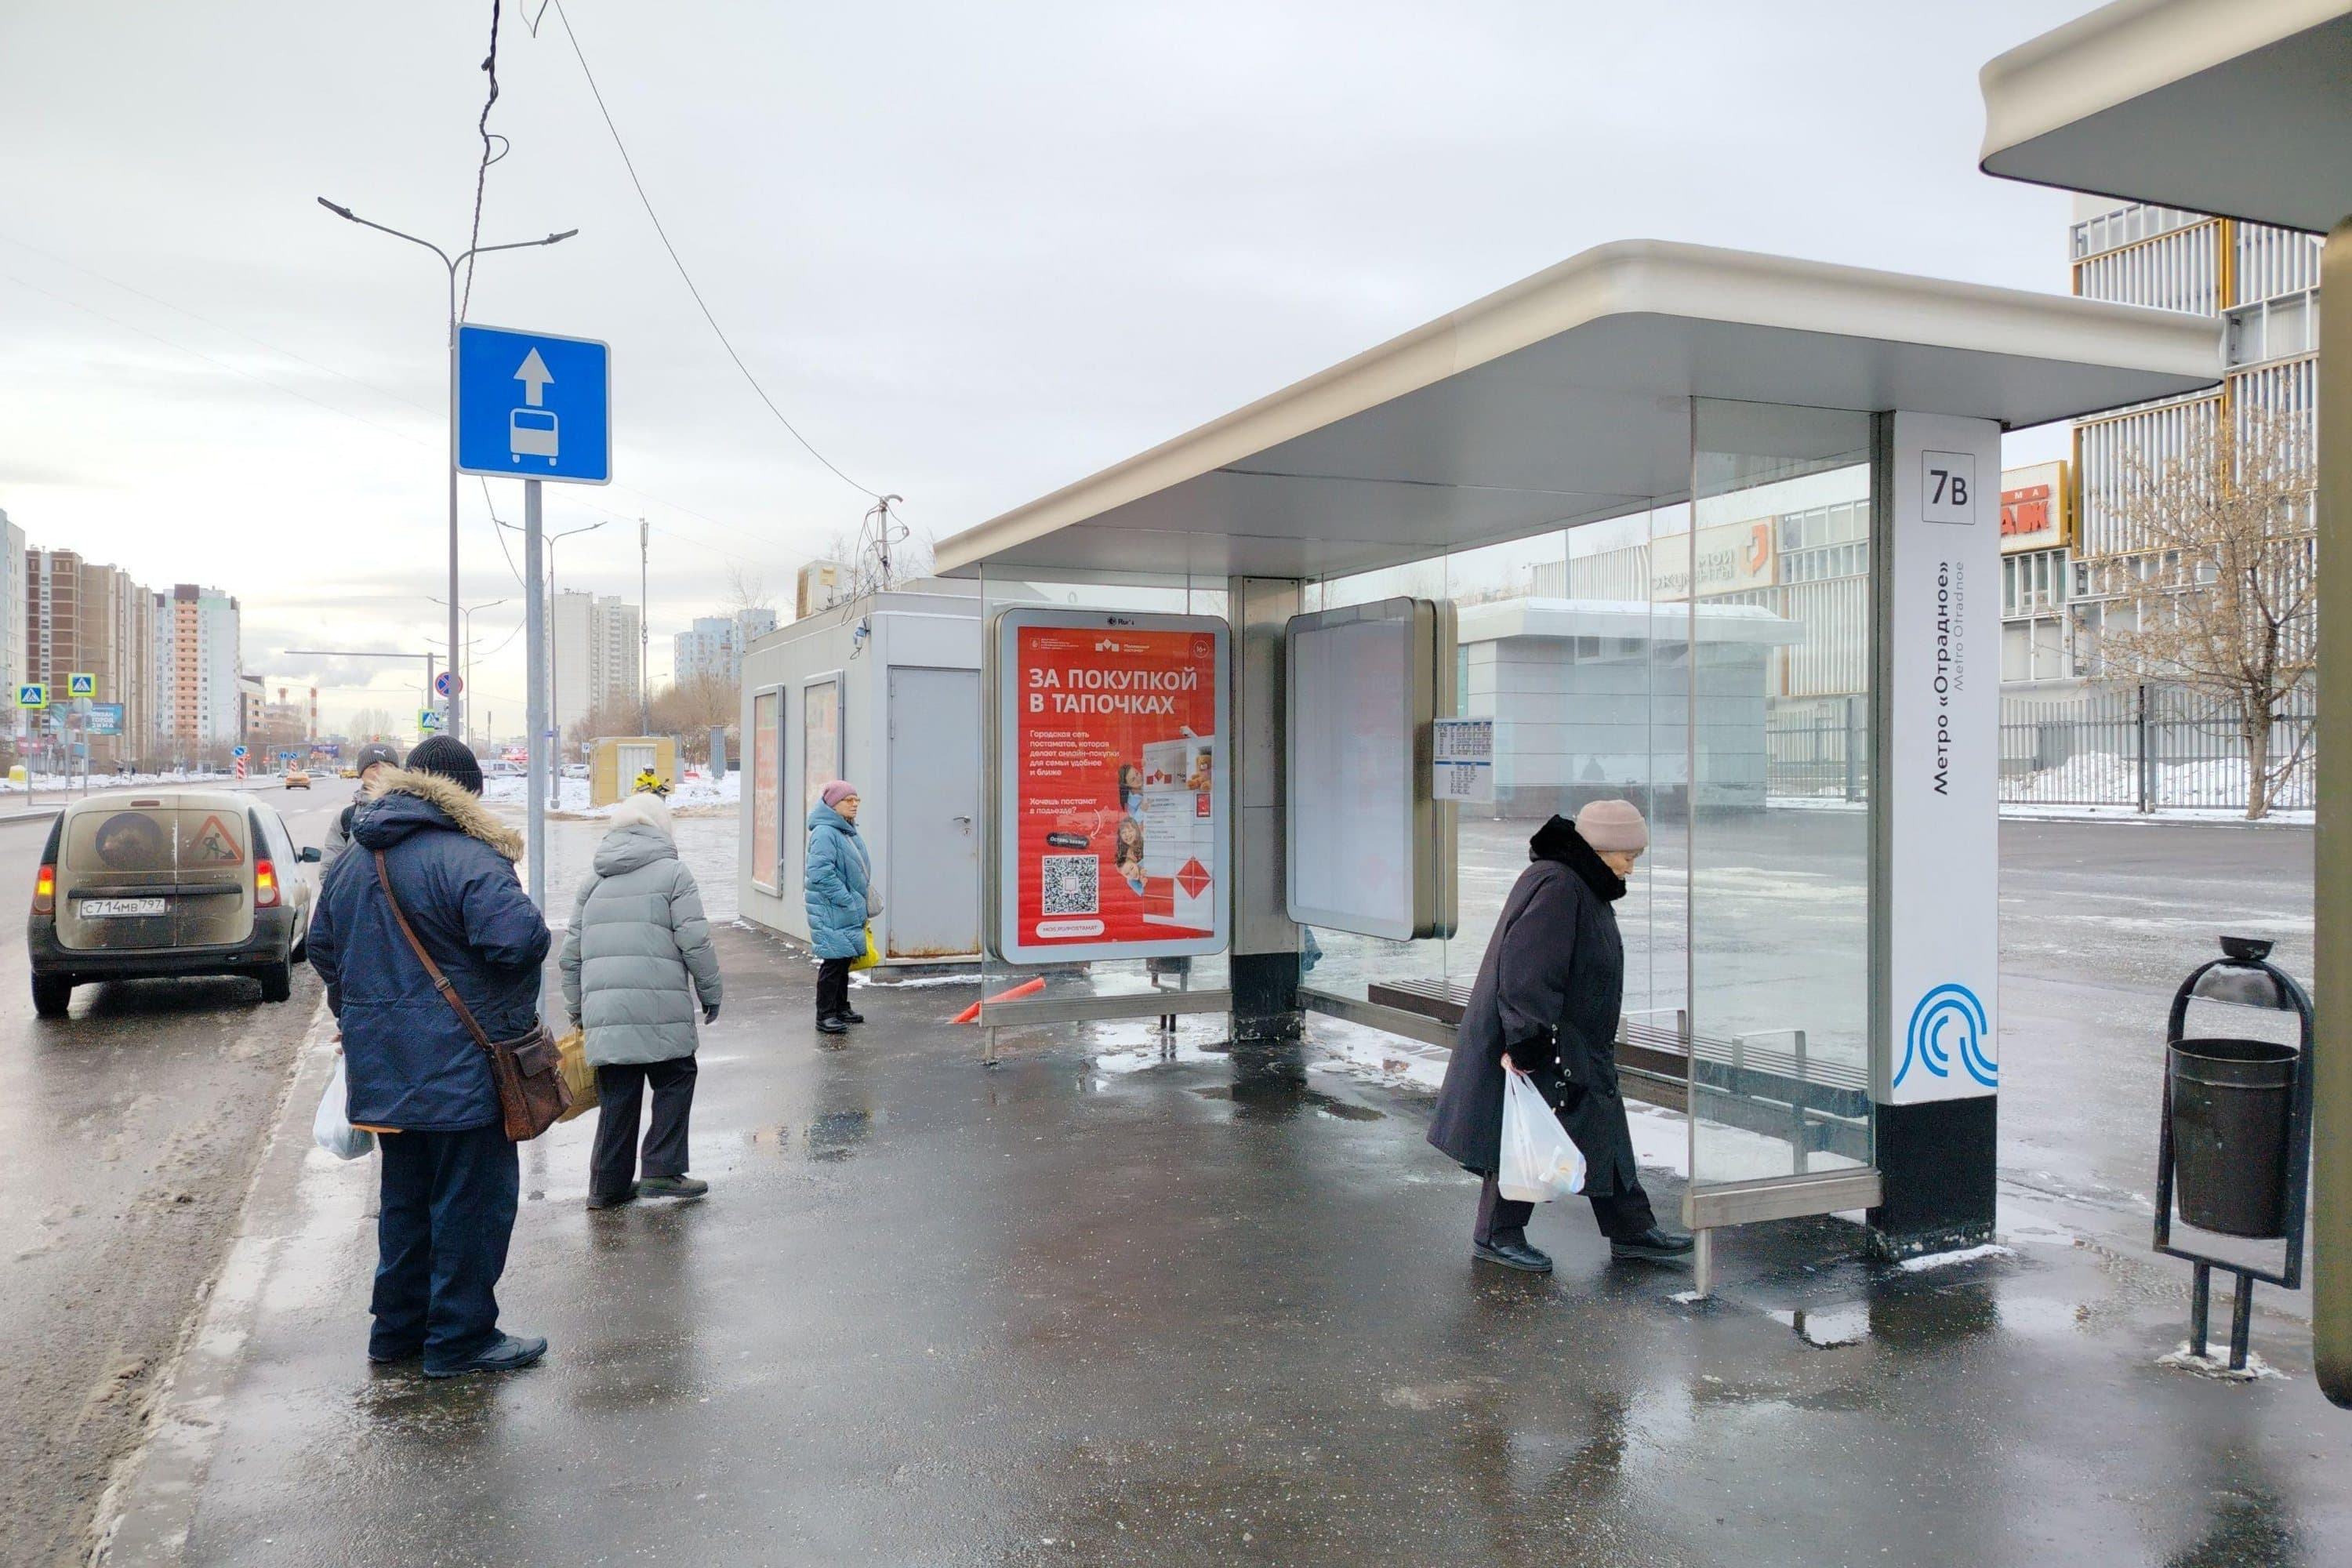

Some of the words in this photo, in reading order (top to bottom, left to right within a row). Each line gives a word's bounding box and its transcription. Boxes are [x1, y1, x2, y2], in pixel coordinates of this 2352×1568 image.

[1953, 561, 1964, 637] Otradnoe
[1933, 561, 1951, 706] «Отрадное»
[1029, 668, 1060, 688] ЗА
[1068, 666, 1198, 691] ПОКУПКОЙ
[1954, 643, 1964, 691] Metro
[1029, 693, 1044, 713] В
[1051, 693, 1174, 714] ТАПОЧКАХ
[1029, 730, 1071, 739] Городская
[1071, 759, 1102, 768] удобнее
[1933, 714, 1951, 796] Метро
